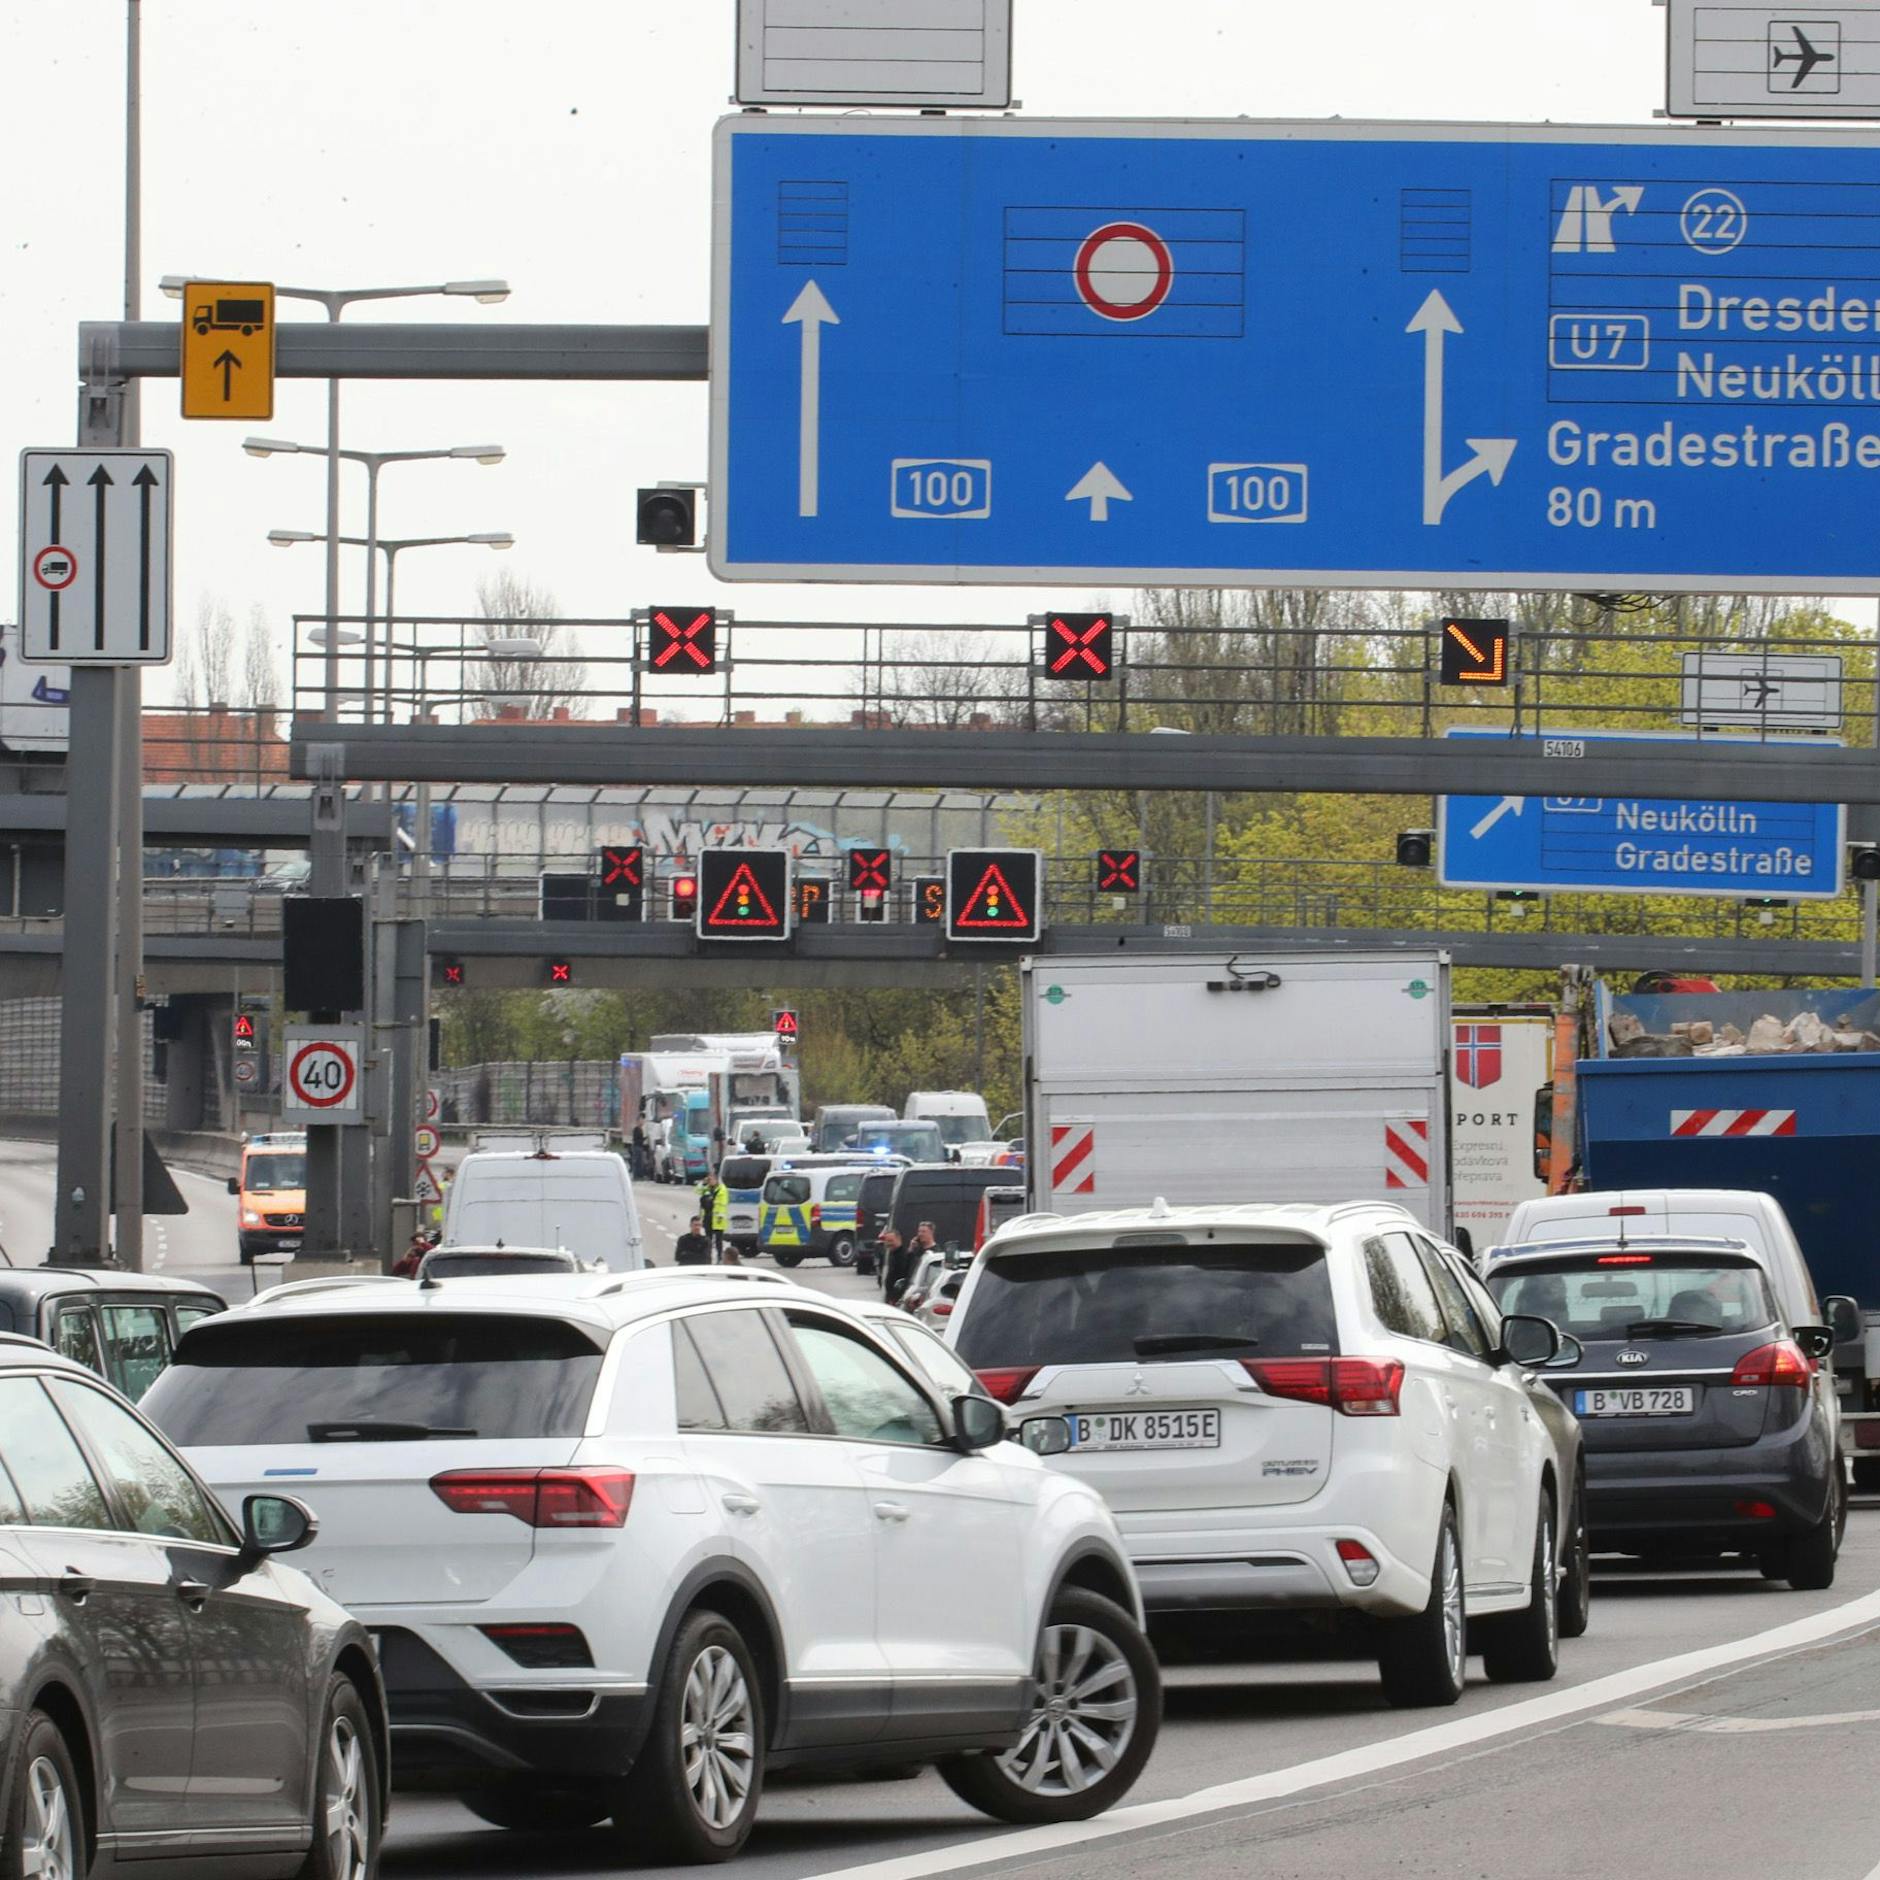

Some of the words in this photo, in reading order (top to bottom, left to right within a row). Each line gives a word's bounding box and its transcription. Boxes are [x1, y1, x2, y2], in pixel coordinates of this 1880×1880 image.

[1692, 204, 1736, 239] 22
[1548, 420, 1880, 469] Gradestraße
[910, 471, 973, 506] 100
[1226, 475, 1290, 511] 100
[1547, 487, 1602, 528] 80
[1615, 499, 1656, 529] m
[1547, 741, 1581, 757] 54106
[1616, 802, 1757, 834] Neukölln
[1615, 841, 1812, 876] Gradestraße
[303, 1060, 341, 1090] 40
[1622, 1353, 1643, 1364] KIA
[1593, 1392, 1606, 1411] B
[1620, 1391, 1645, 1410] VB
[1648, 1390, 1685, 1410] 728
[1077, 1418, 1091, 1442] B
[1109, 1416, 1137, 1441] DK
[1144, 1413, 1216, 1440] 8515E
